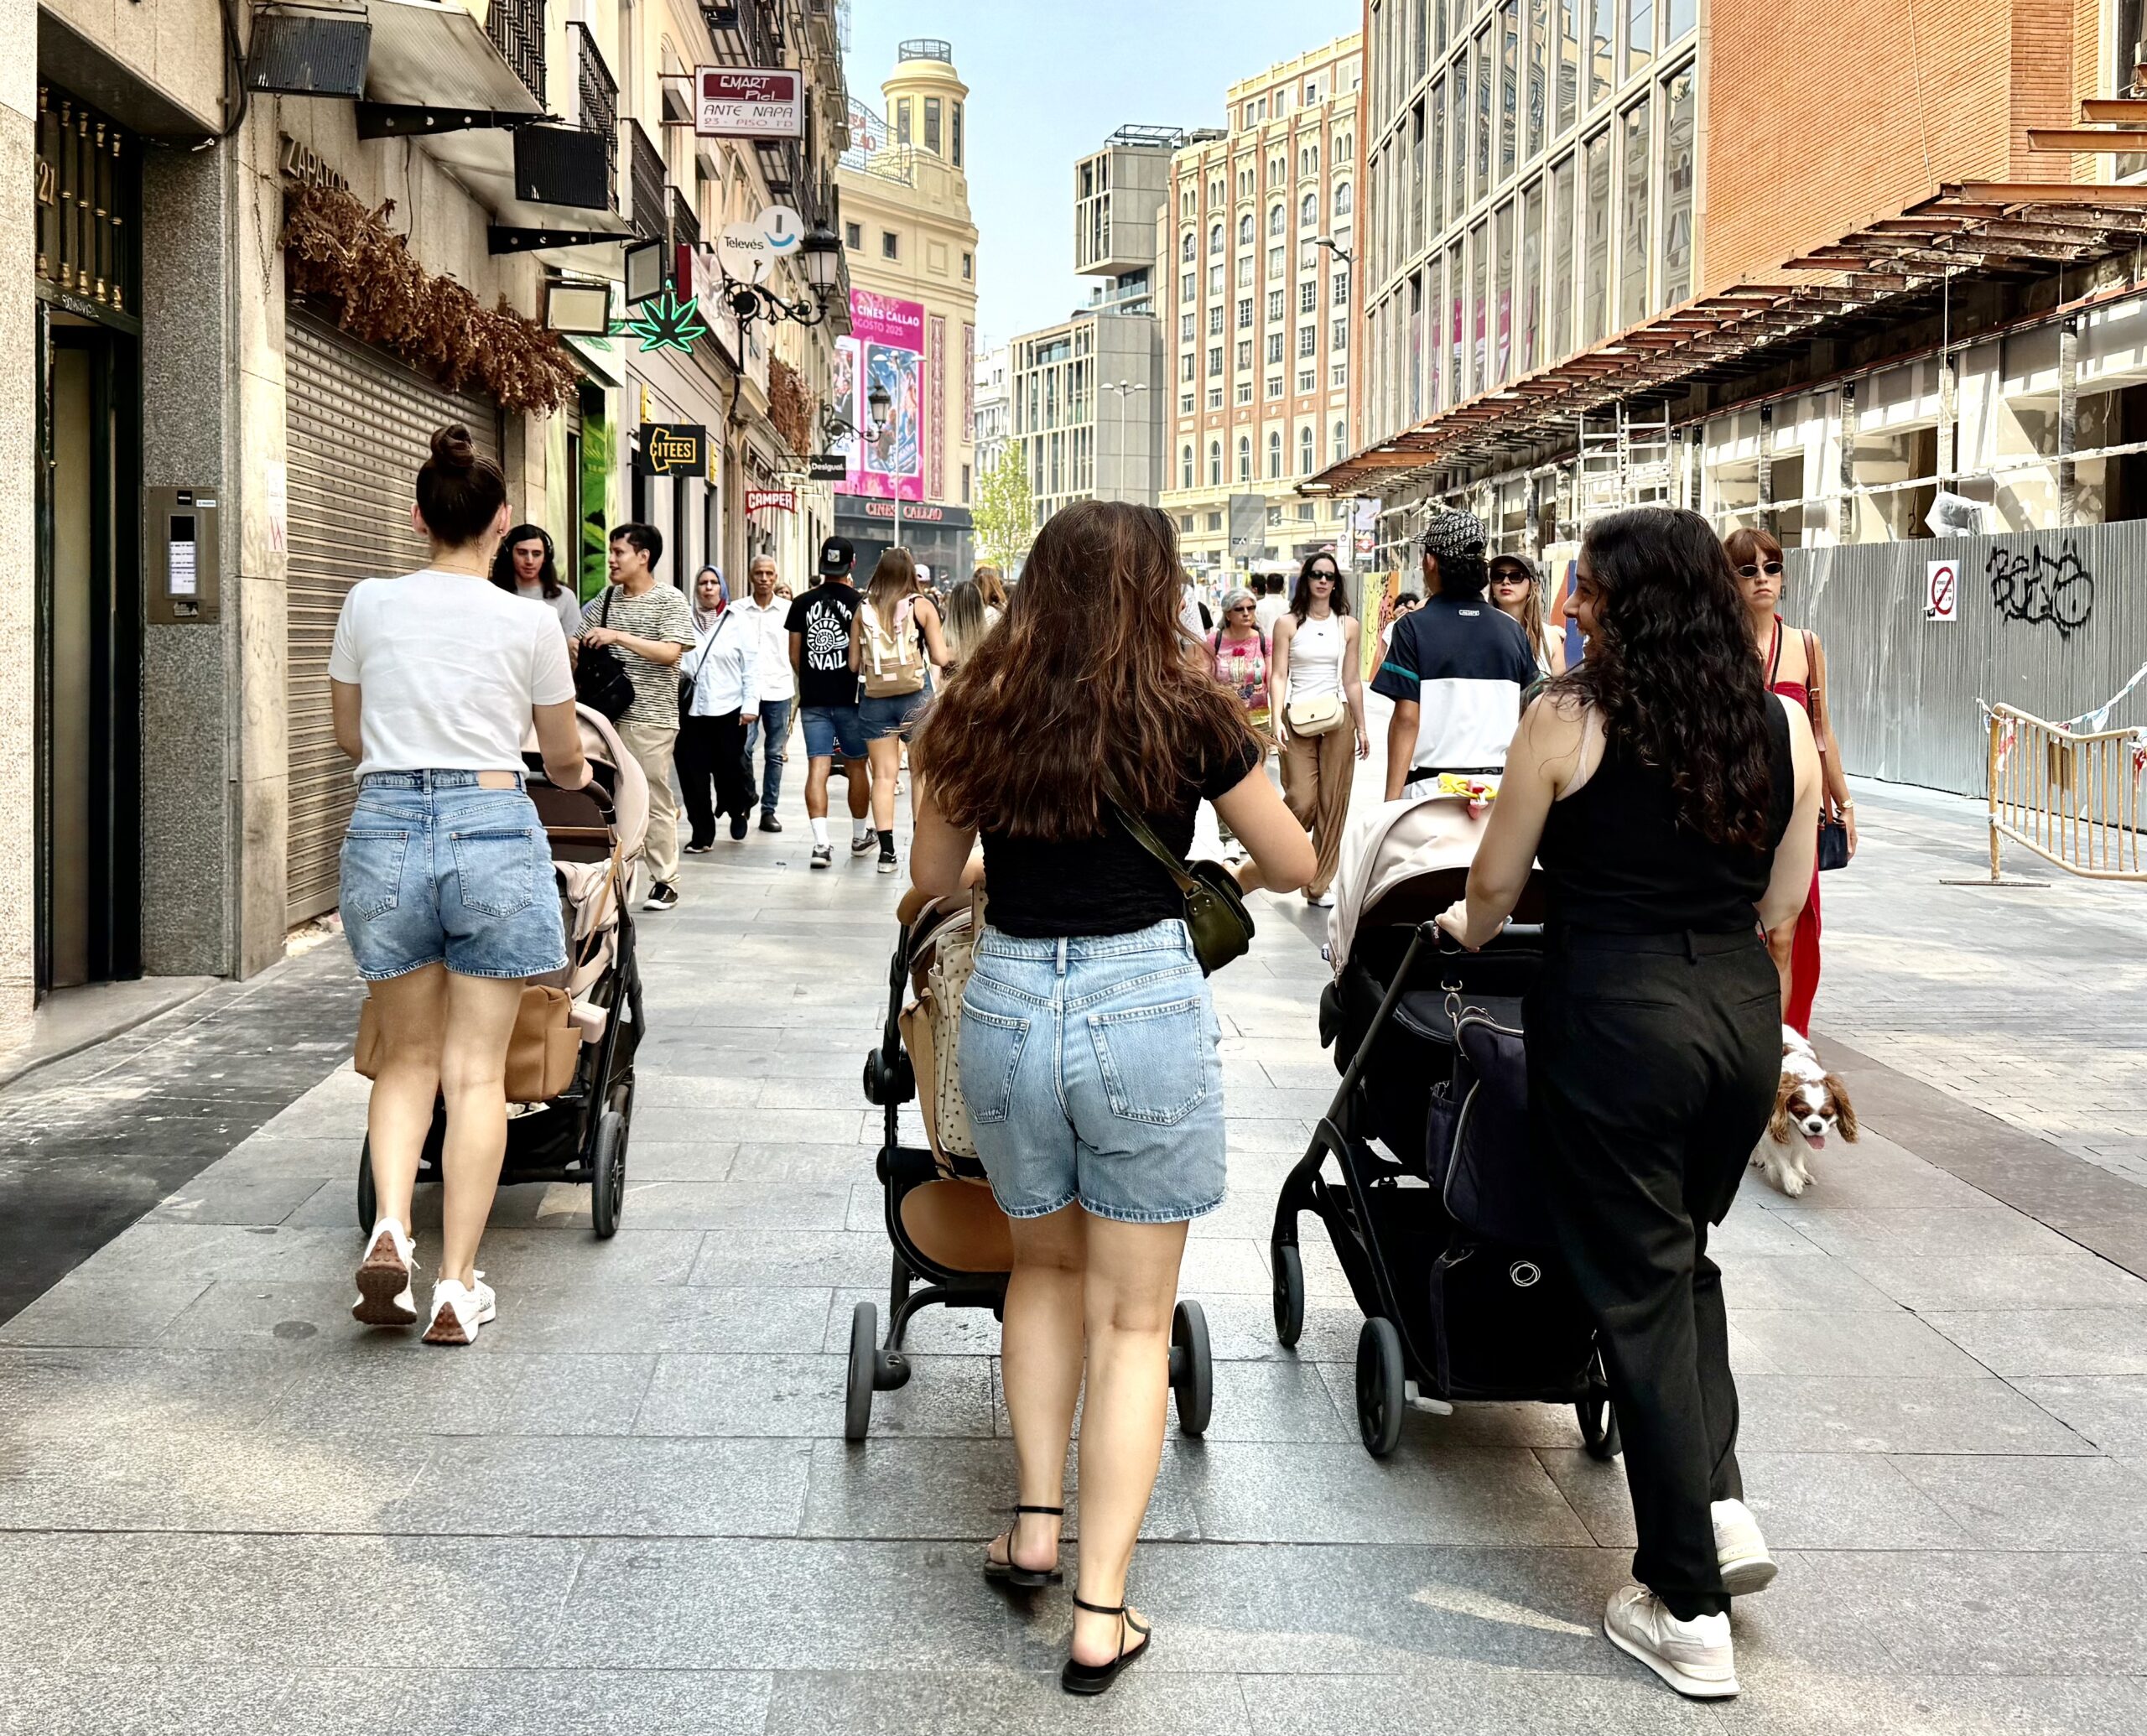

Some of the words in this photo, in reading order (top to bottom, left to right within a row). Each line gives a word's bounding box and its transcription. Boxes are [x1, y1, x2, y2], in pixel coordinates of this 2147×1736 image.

[704, 104, 743, 117] ANTE
[752, 106, 793, 118] NAPA
[39, 162, 55, 205] 21
[724, 236, 764, 250] Televés
[857, 304, 885, 320] CINES
[886, 311, 920, 327] CALLAO
[886, 324, 904, 336] 2025
[650, 442, 691, 458] CITEES
[748, 492, 793, 510] CAMPER
[866, 502, 896, 517] CINES
[903, 506, 943, 521] CALLAO
[808, 650, 847, 671] SNAIL
